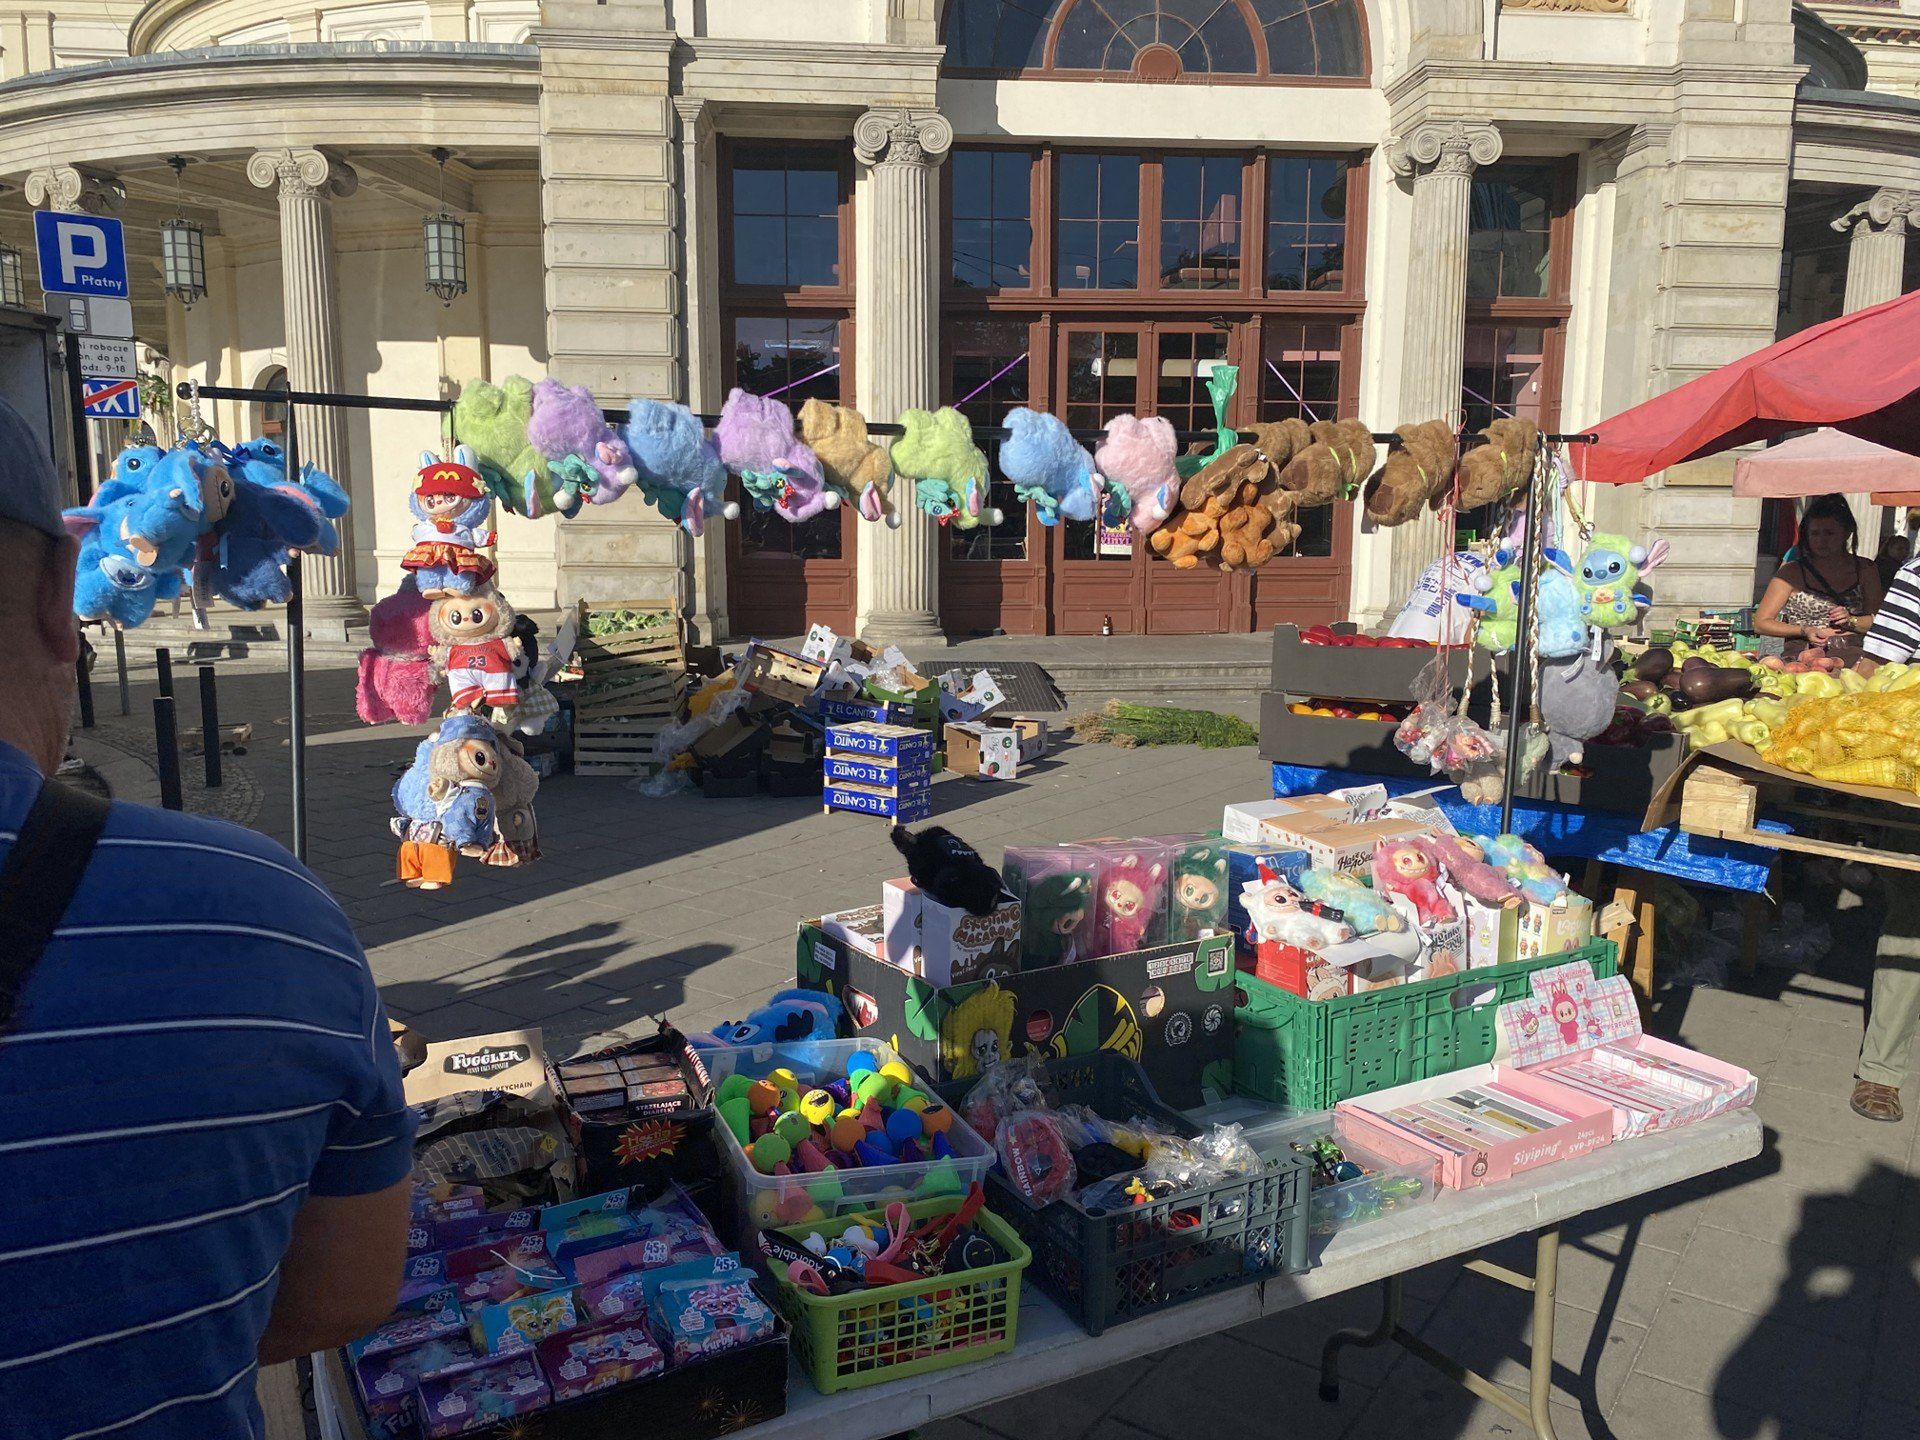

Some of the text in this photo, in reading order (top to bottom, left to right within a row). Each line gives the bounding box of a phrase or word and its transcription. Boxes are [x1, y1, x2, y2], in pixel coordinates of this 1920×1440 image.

[57, 221, 107, 284] P
[81, 274, 122, 291] Płatny
[90, 342, 129, 353] robocze
[97, 353, 110, 362] do
[114, 355, 127, 365] pt.
[82, 362, 126, 373] odz. 9-18
[83, 382, 136, 414] AXI
[468, 655, 487, 669] 23
[836, 704, 843, 714] EL
[868, 740, 877, 751] EL
[868, 769, 877, 780] EL
[868, 799, 877, 810] EL
[962, 906, 1020, 931] EXCITING
[451, 1050, 522, 1071] FUGGLER
[495, 1081, 533, 1092] KEYCHAIN
[1513, 1143, 1558, 1166] Siyiping
[1012, 1147, 1033, 1197] RAINBOW
[607, 1193, 627, 1204] 45+
[510, 1211, 532, 1222] 45+
[523, 1235, 545, 1247] 45+
[645, 1240, 668, 1254] 45+
[416, 1257, 439, 1270] 45+
[715, 1257, 738, 1270] 45+
[702, 1332, 738, 1351] Furby
